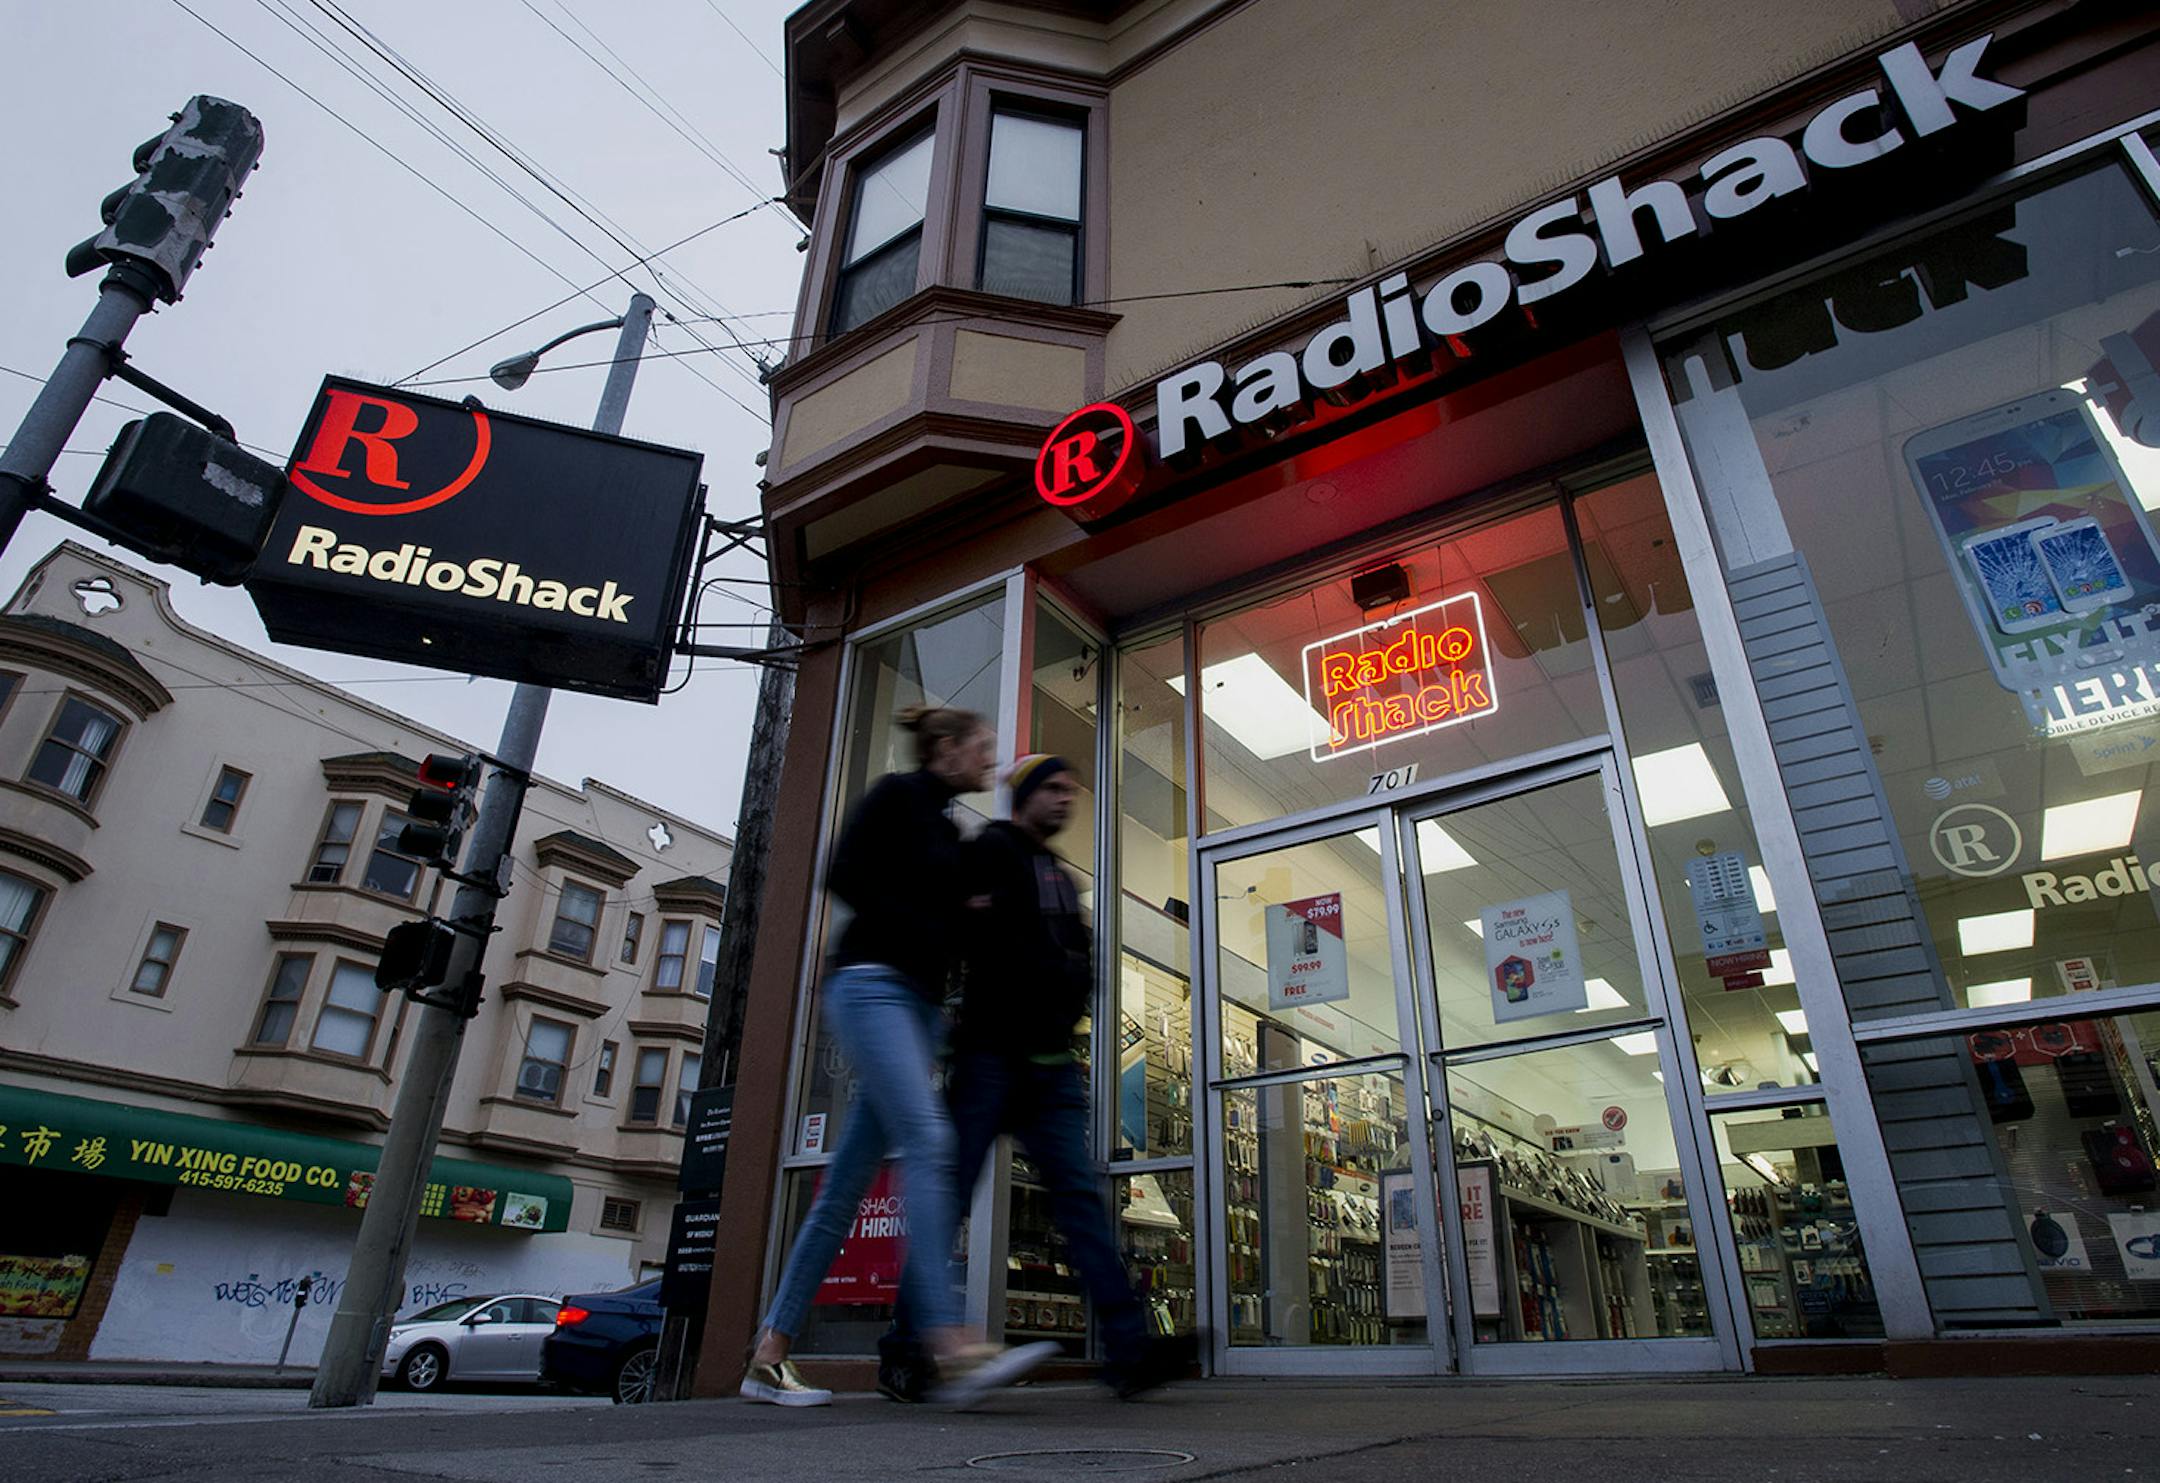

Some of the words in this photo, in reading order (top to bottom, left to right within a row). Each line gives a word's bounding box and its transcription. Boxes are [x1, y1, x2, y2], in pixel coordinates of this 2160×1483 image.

[1157, 34, 2026, 459] RadioShack
[295, 388, 419, 490] R
[1932, 451, 2016, 491] 12:45
[287, 524, 635, 623] RadioShack
[1321, 627, 1473, 697] Radio
[1328, 669, 1490, 748] Shack
[2045, 719, 2085, 736] OBILE
[2088, 708, 2140, 727] DEVICE
[2093, 741, 2136, 759] Sprint
[1369, 766, 1413, 795] 701
[1939, 824, 2000, 868] R
[1307, 904, 1340, 919] $79.99
[1494, 917, 1528, 929] Samsung
[1495, 922, 1539, 941] GALAXY
[1291, 960, 1322, 974] $99.99
[1711, 955, 1735, 968] NOW
[1284, 984, 1307, 997] FREE
[130, 1139, 174, 1167] YIN
[175, 1146, 238, 1175] XING
[239, 1156, 304, 1184] FOOD
[305, 1164, 341, 1189] CO.
[178, 1170, 286, 1196] 415-597-6235
[1467, 1185, 1482, 1202] IT
[1461, 1203, 1484, 1221] RE
[860, 1216, 913, 1239] HIRIN
